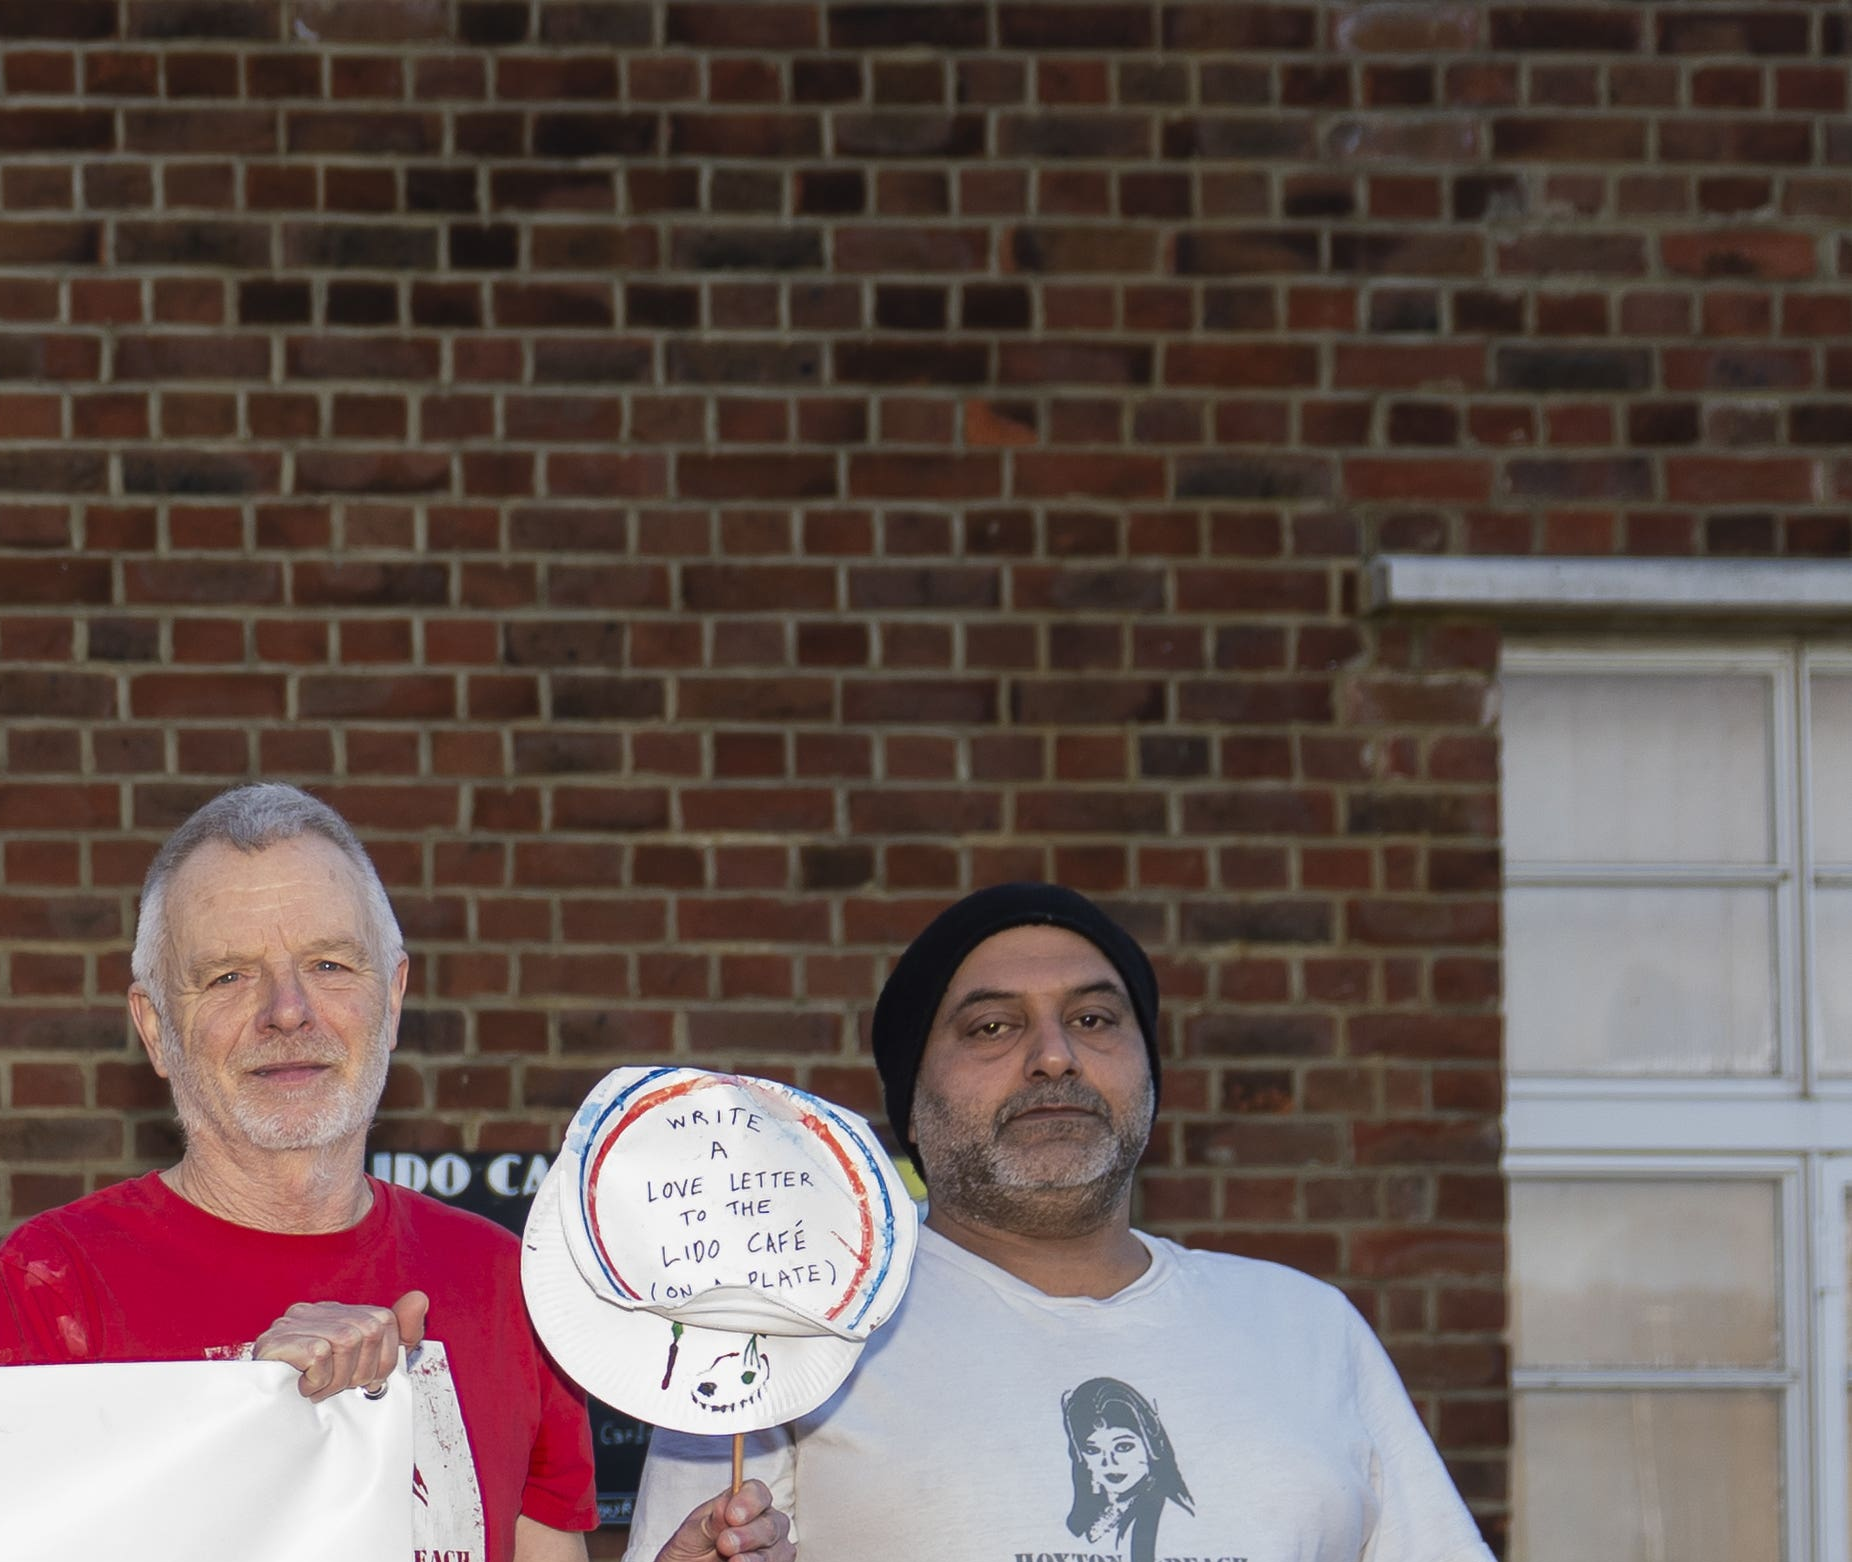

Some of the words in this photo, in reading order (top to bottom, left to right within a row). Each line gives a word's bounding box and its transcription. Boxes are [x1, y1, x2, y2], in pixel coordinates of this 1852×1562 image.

[666, 1107, 764, 1133] WRITE
[710, 1141, 728, 1160] A
[372, 1152, 472, 1198] IDO
[487, 1153, 550, 1198] CA
[647, 1176, 704, 1203] LOVE
[730, 1171, 815, 1192] LETTER
[679, 1209, 707, 1226] TO
[725, 1199, 772, 1217] THE
[662, 1239, 721, 1268] LIDO
[747, 1219, 807, 1254] CAFÉ
